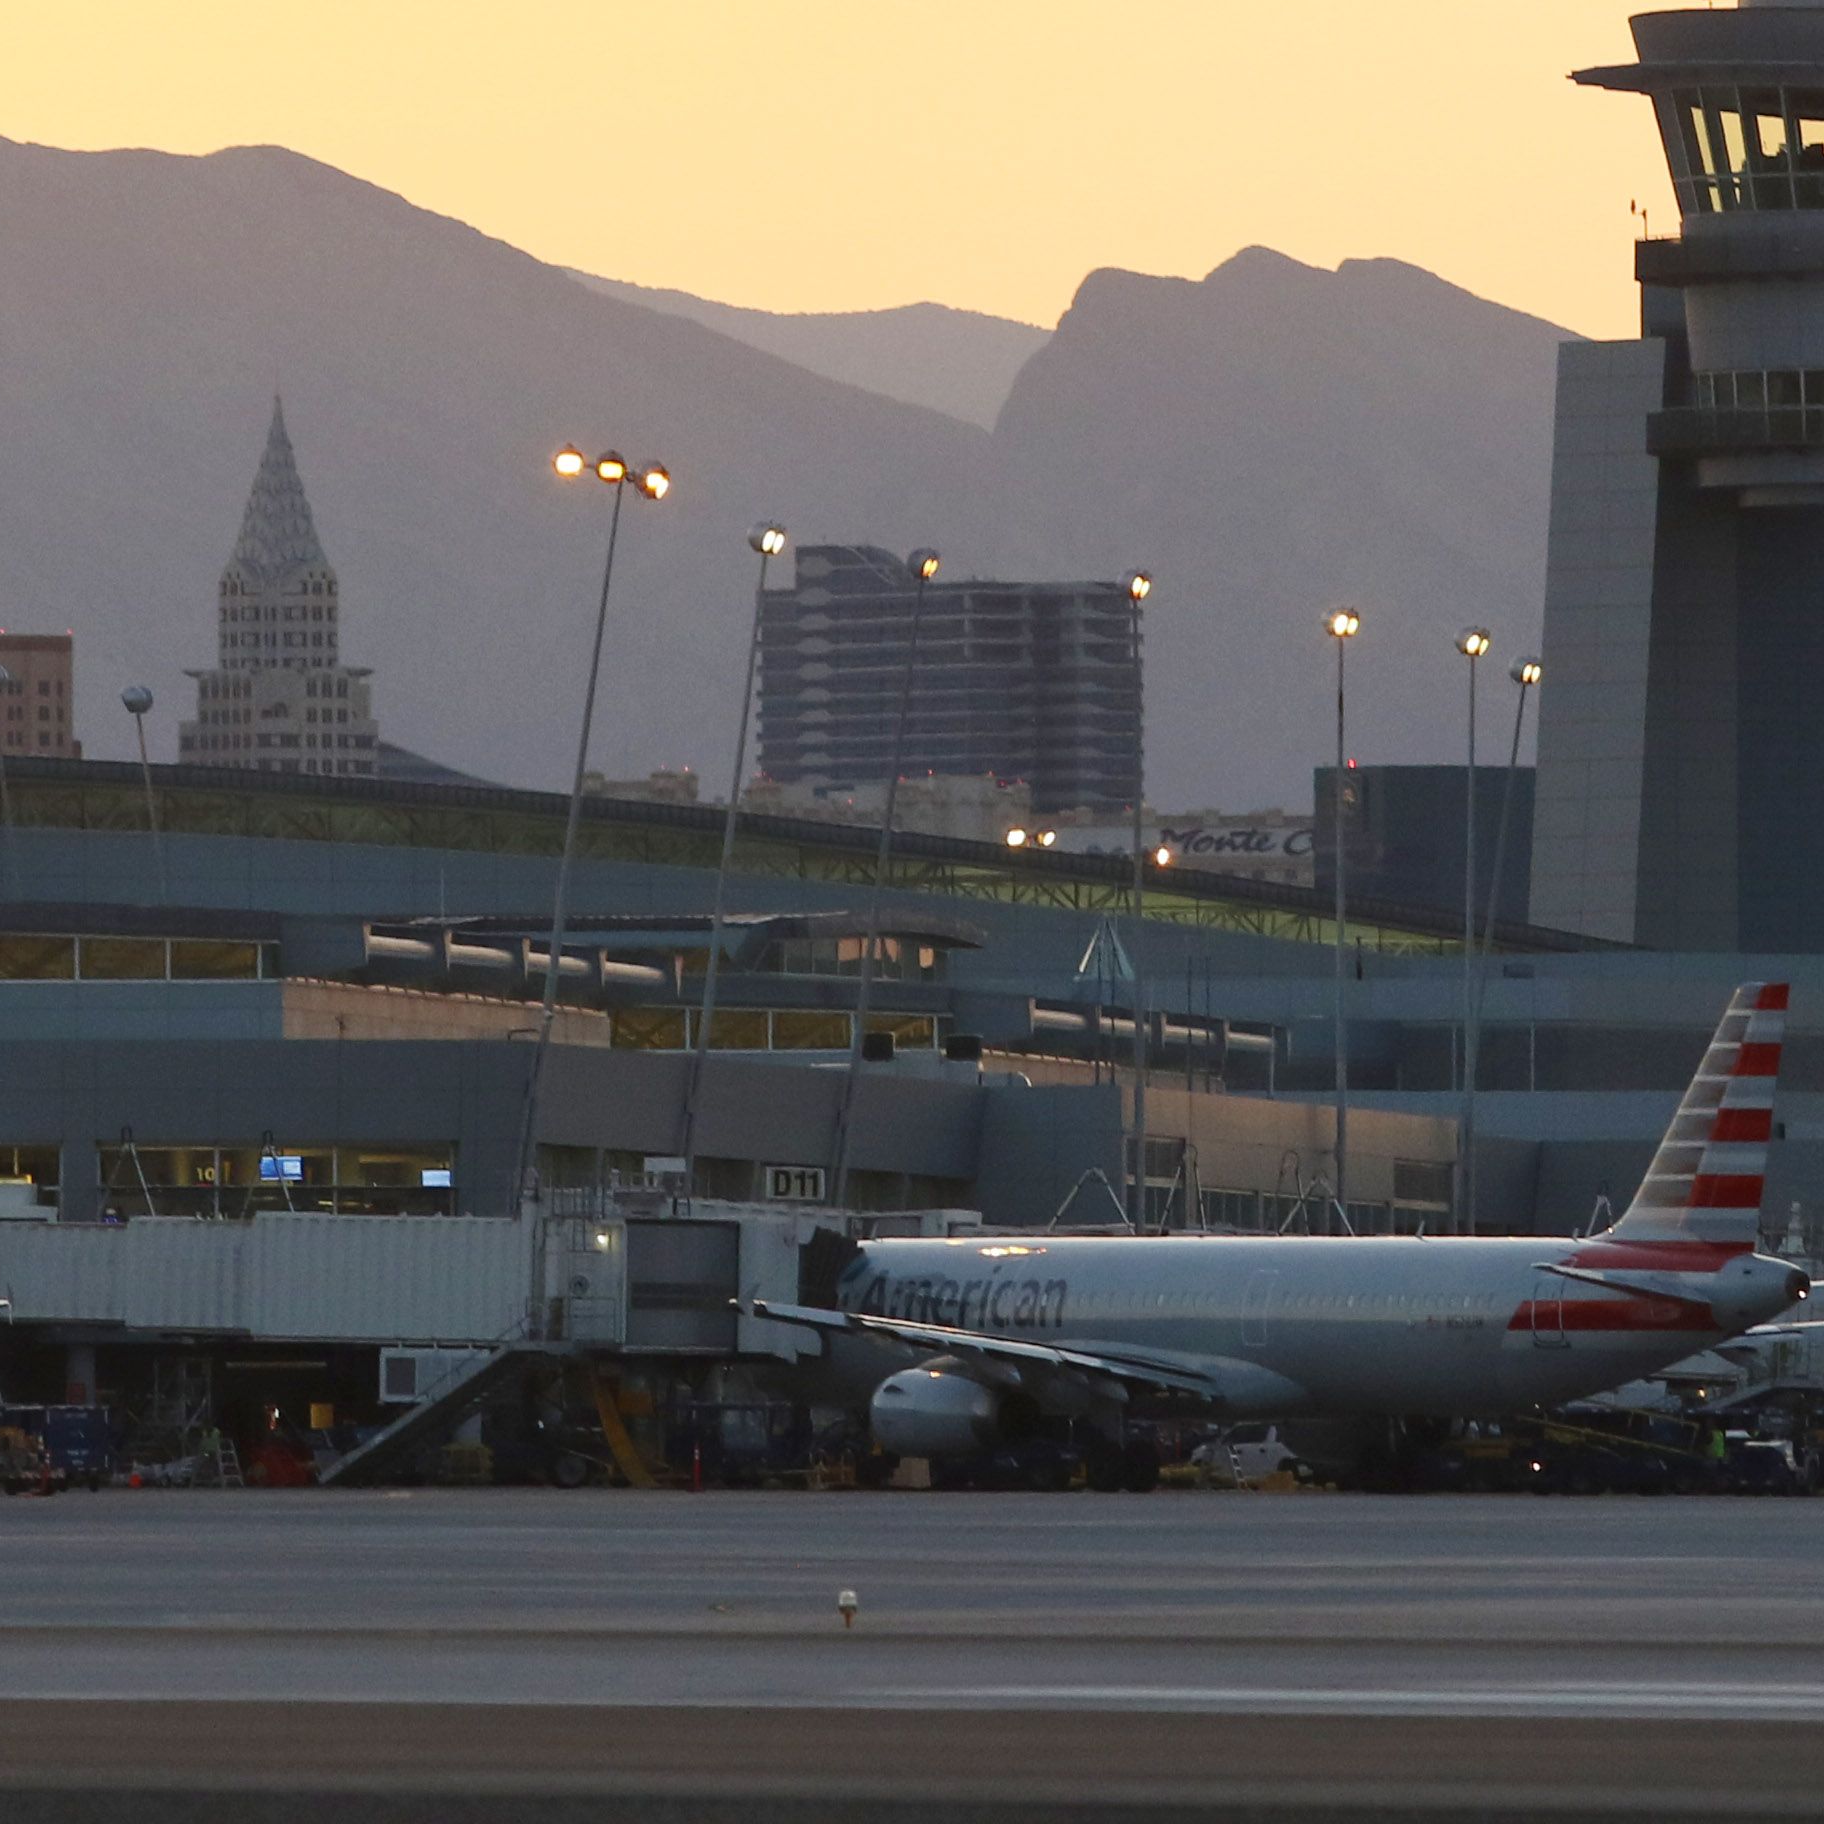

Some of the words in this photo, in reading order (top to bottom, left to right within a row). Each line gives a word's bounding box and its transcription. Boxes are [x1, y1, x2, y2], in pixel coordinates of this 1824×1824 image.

[1160, 828, 1275, 853] Monte
[773, 1170, 819, 1198] D11
[859, 1264, 1068, 1328] American
